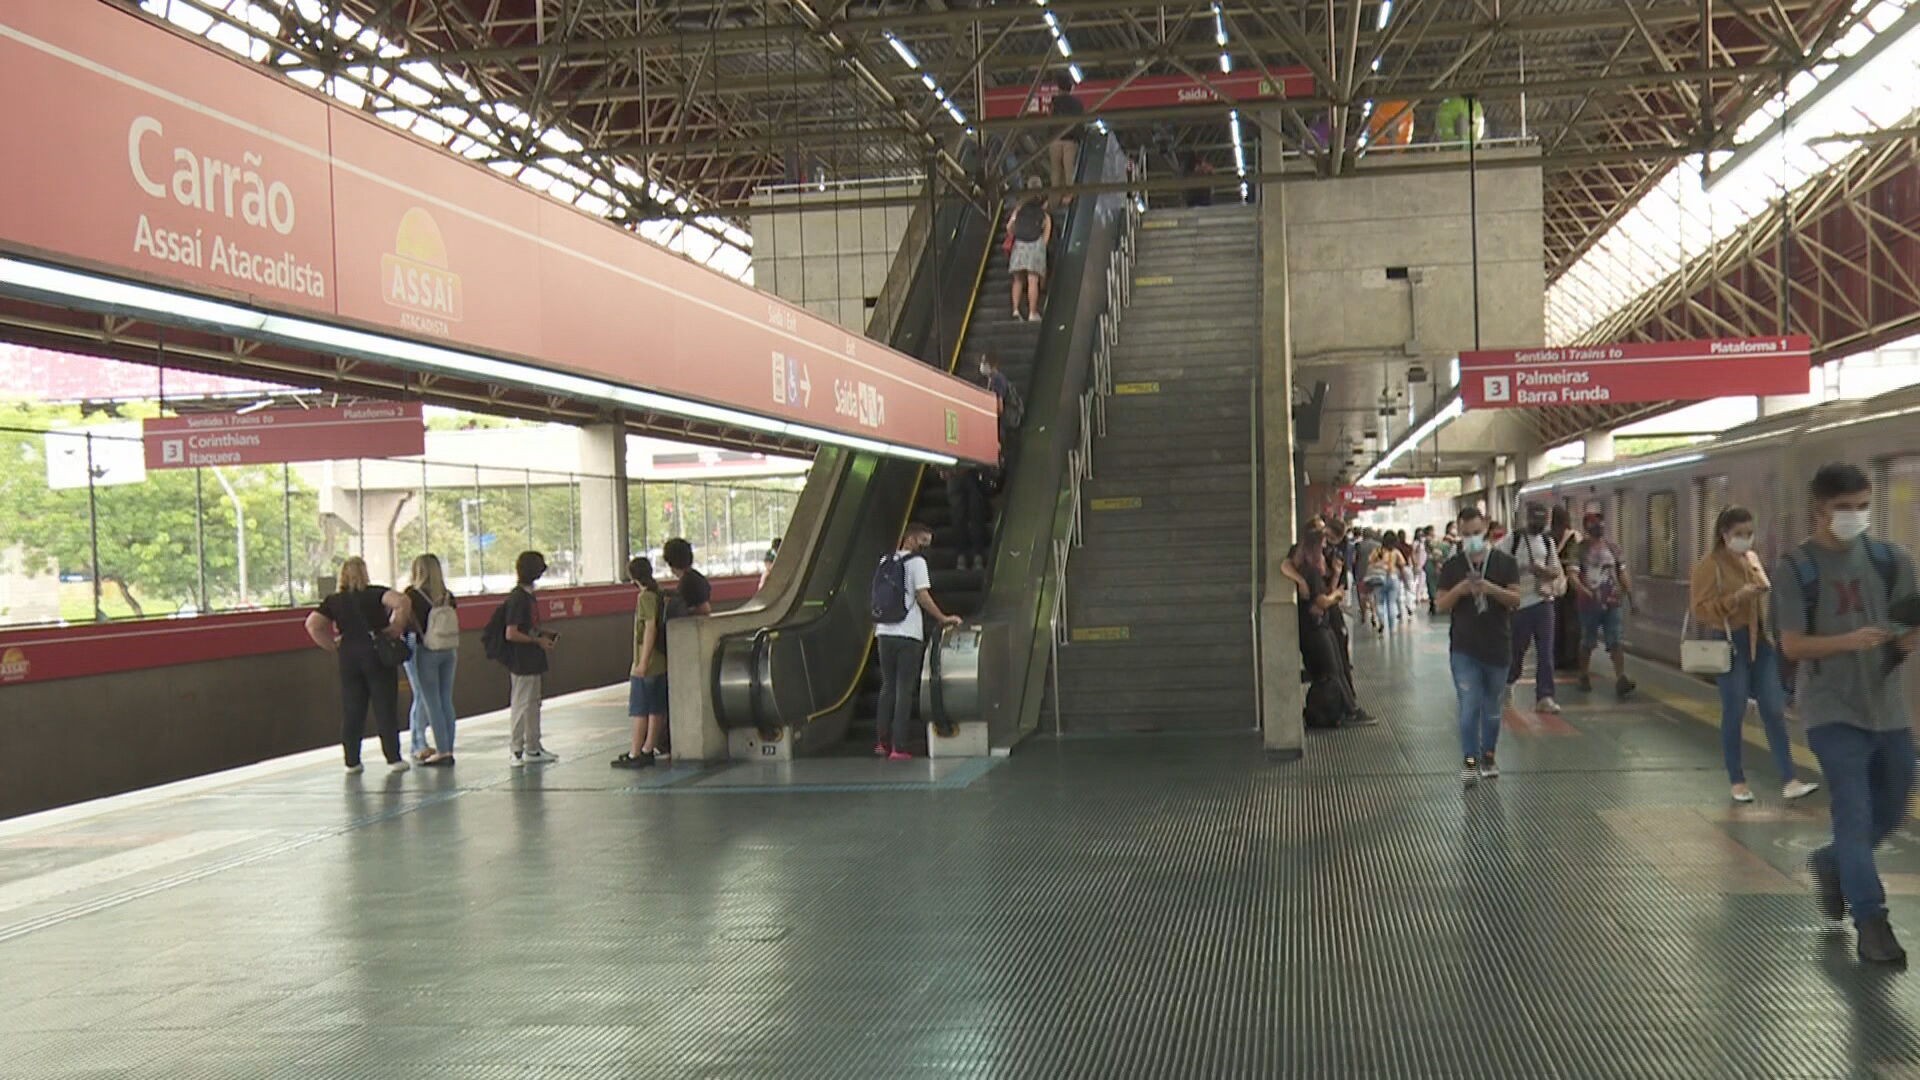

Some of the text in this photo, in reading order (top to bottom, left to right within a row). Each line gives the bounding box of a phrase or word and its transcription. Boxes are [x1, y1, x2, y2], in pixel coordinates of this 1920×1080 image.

[127, 115, 296, 235] Carrão
[133, 214, 325, 298] Assaí Atacadista
[1515, 351, 1559, 363] Sentido
[1569, 349, 1606, 360] Trains
[1609, 348, 1623, 359] to
[1710, 340, 1787, 354] Plataforma 1
[1516, 369, 1590, 387] Palmeiras
[834, 379, 858, 419] Saída
[1517, 384, 1610, 404] Barra Funda
[187, 415, 224, 428] Sentido
[231, 414, 260, 425] Trains
[262, 415, 274, 424] to
[343, 408, 396, 419] Plataforma
[188, 432, 260, 449] Corinthians
[189, 451, 241, 467] Itaquera
